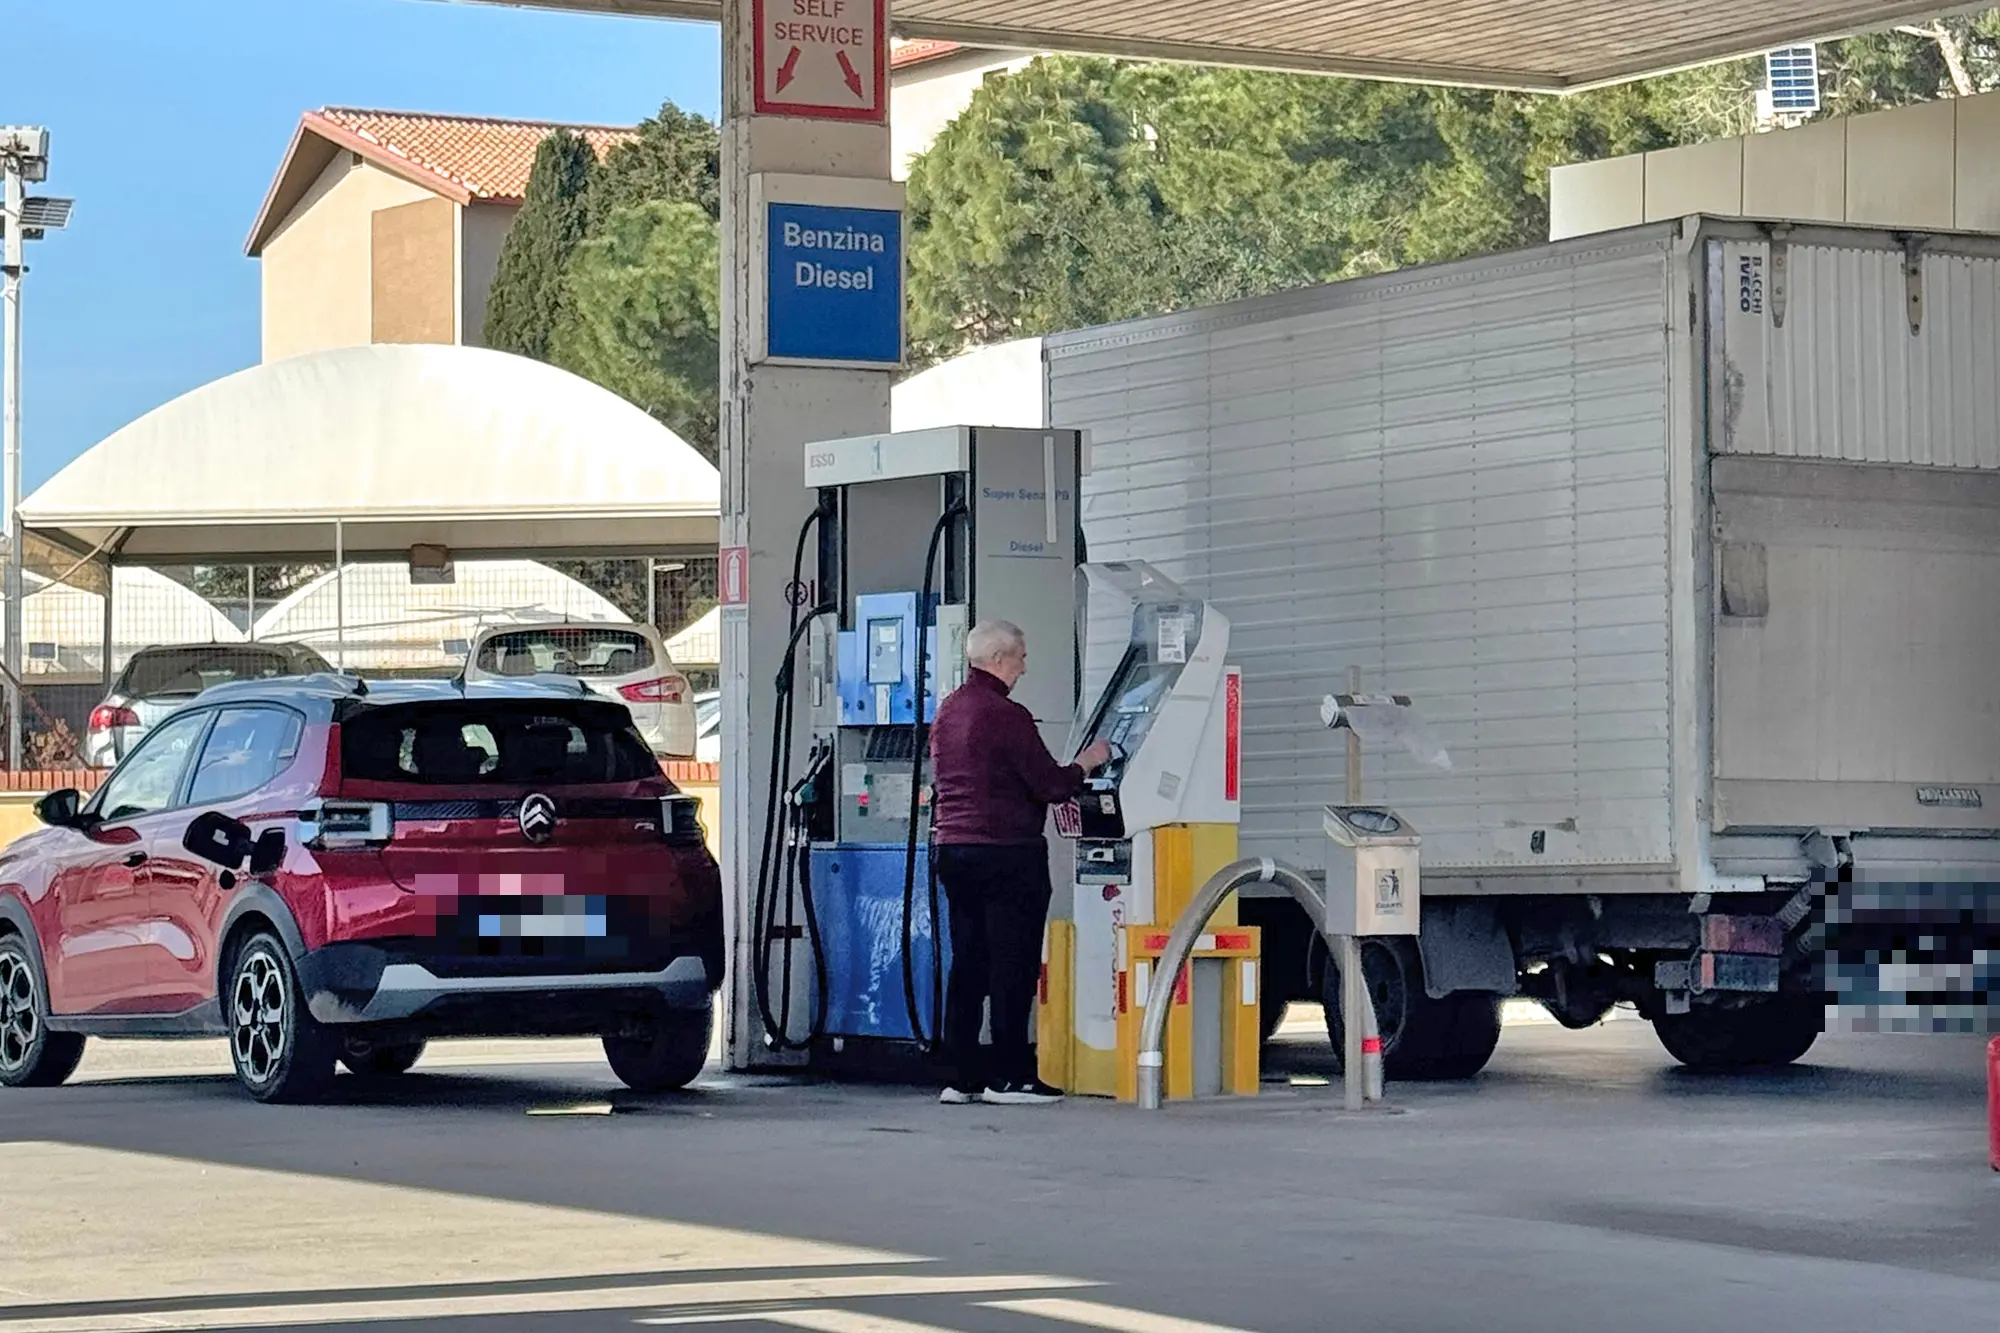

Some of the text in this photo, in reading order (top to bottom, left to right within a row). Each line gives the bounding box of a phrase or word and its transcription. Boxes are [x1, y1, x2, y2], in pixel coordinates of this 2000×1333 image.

[793, 0, 845, 18] SELF
[774, 22, 863, 46] SERVICE
[783, 221, 885, 253] Benzina
[795, 261, 874, 290] Diesel
[1740, 255, 1751, 313] IVECO
[983, 487, 1015, 501] Super
[1010, 541, 1044, 553] Diesel
